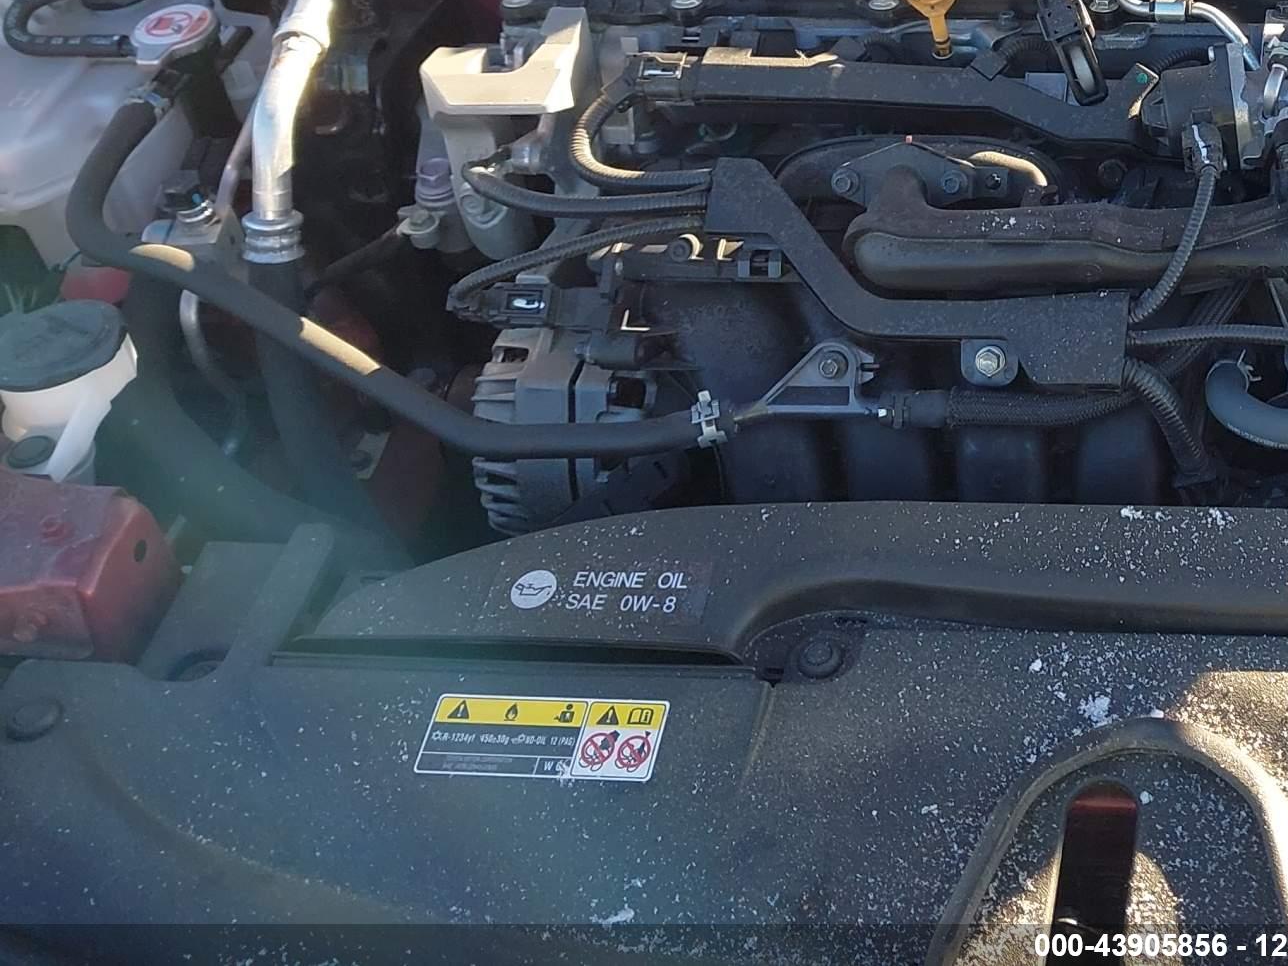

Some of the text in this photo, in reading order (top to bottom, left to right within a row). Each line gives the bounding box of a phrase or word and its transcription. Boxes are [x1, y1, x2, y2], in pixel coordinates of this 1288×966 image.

[573, 571, 688, 589] ENGINE OIL
[565, 593, 677, 613] SAE 0W-8
